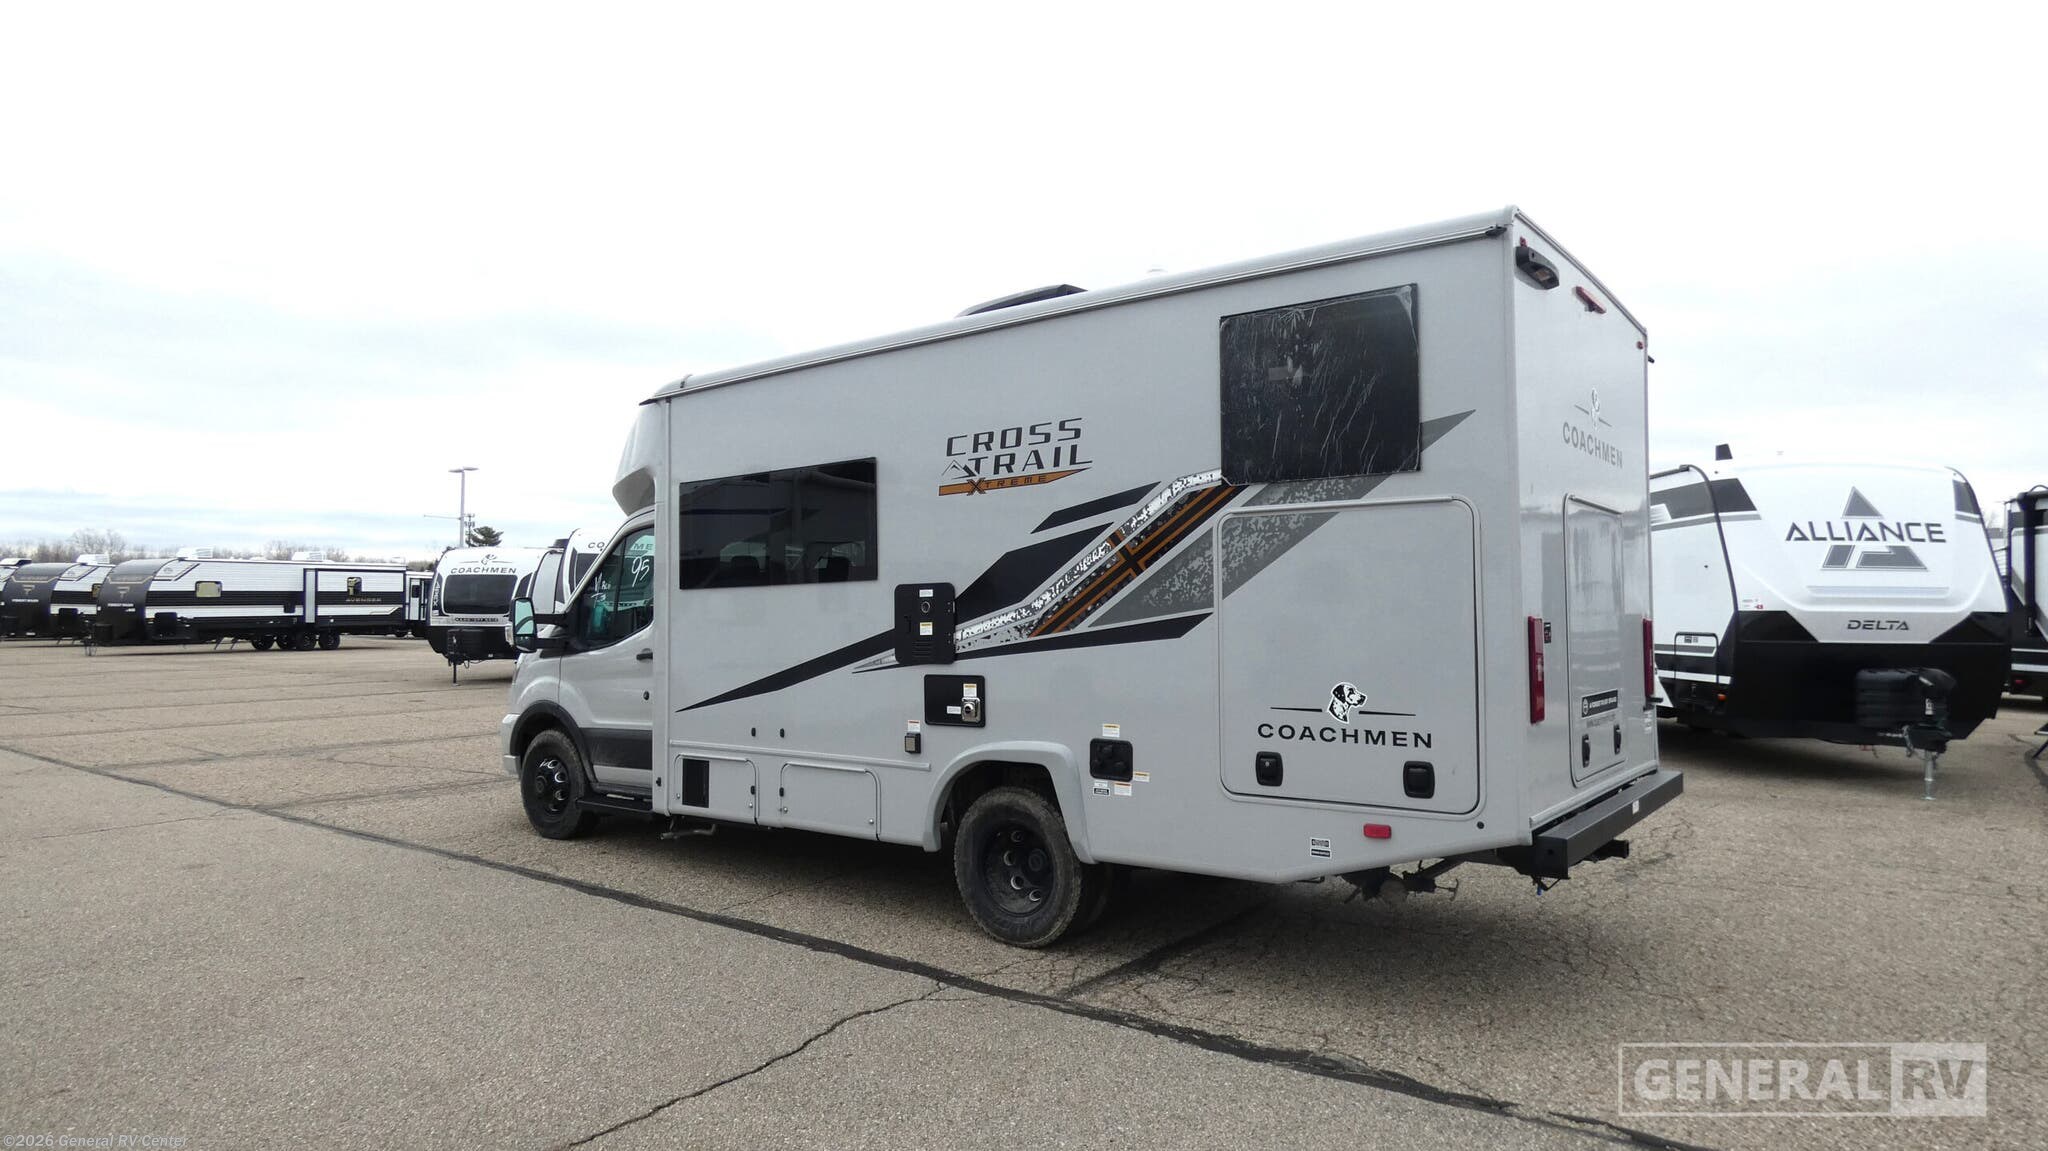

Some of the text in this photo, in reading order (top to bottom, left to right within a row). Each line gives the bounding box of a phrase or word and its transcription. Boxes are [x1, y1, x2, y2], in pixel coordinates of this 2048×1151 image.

[946, 418, 1083, 457] CROSS
[1563, 421, 1623, 469] COACHMEN
[967, 444, 1094, 476] TRAIL
[966, 474, 1048, 497] XTREME
[1785, 521, 1947, 543] ALLIANCE
[450, 566, 518, 574] COACHMEN
[1847, 619, 1910, 631] DELTA
[1257, 723, 1433, 749] COACHMEN
